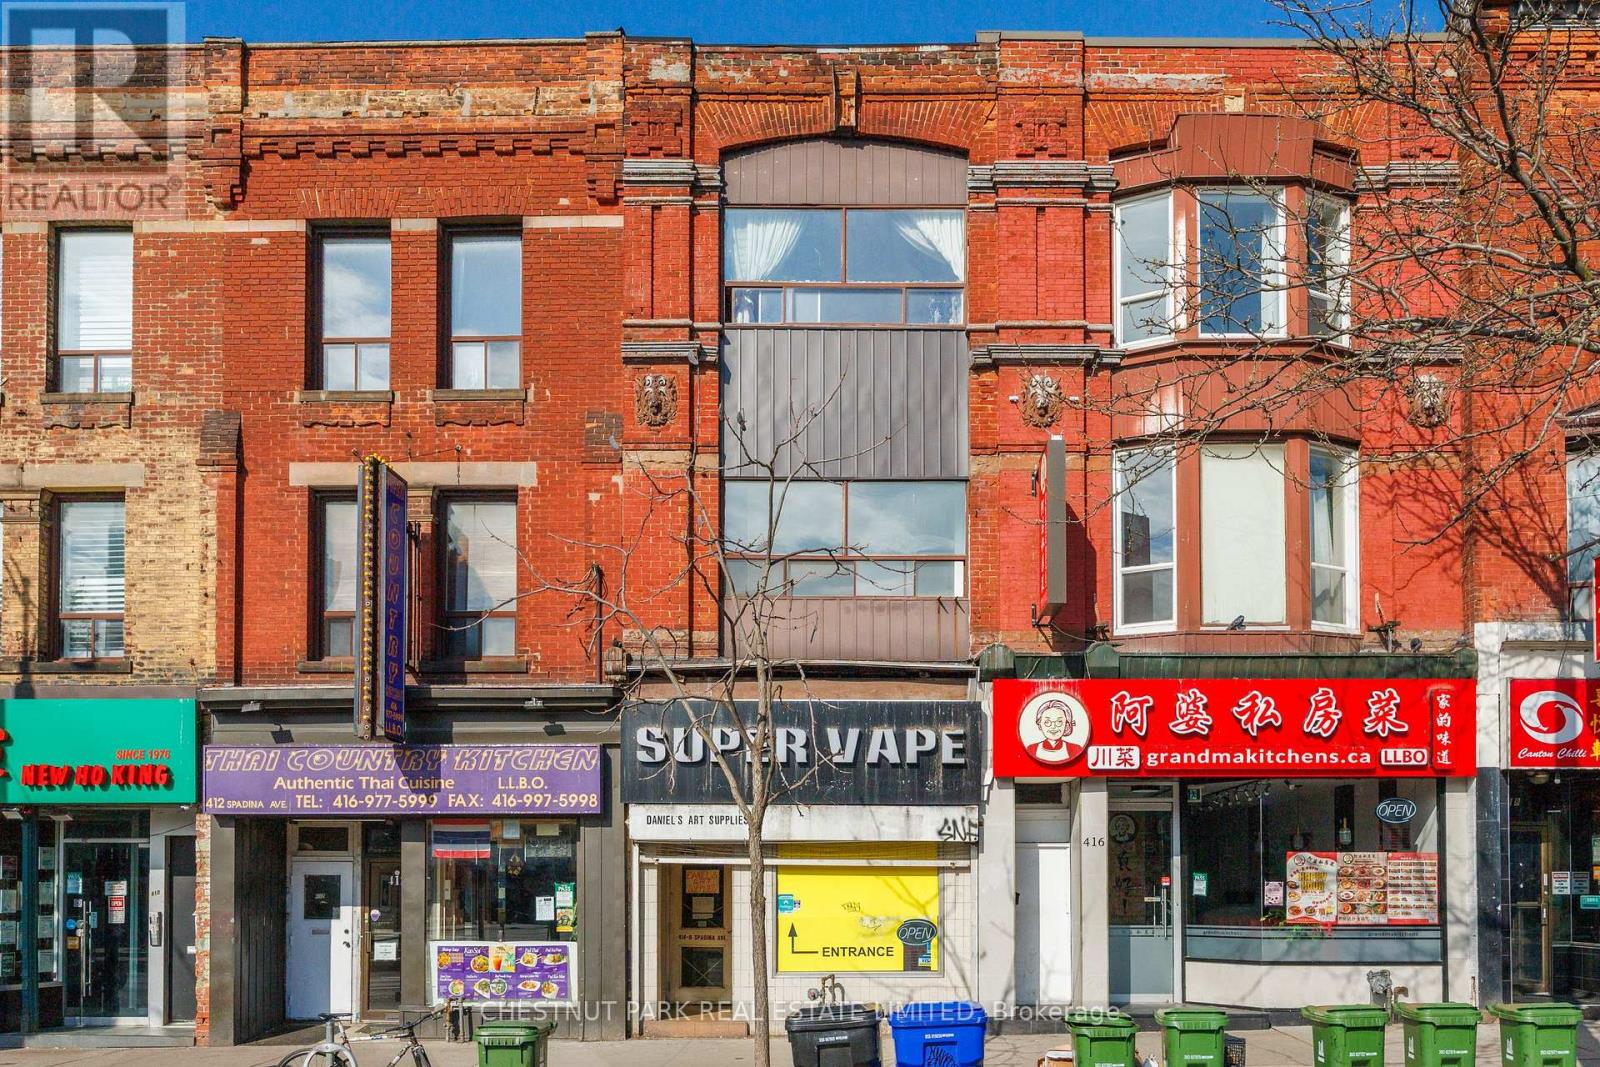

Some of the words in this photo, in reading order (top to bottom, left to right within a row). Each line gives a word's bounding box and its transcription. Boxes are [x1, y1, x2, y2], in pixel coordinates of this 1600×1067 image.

[1111, 688, 1409, 737] 阿婆私房菜
[1436, 693, 1452, 765] 家的味道
[636, 727, 807, 763] SUPER
[827, 727, 965, 764] VAPE
[116, 749, 144, 760] SINCE
[148, 749, 170, 760] 1976
[205, 749, 280, 771] THAI
[287, 749, 448, 771] COUNTRY
[454, 749, 598, 771] KITCHEN
[1091, 747, 1135, 767] 川菜
[1147, 749, 1371, 767] grandmakitchens.ca
[1384, 750, 1425, 763] LLBO
[1518, 747, 1554, 759] Canton
[1557, 747, 1587, 759] Chilli
[21, 764, 72, 786] NEW
[75, 764, 107, 786] HO
[111, 764, 170, 786] KING
[273, 776, 354, 790] Authentic
[359, 776, 394, 790] Thai
[398, 776, 455, 790] Cuisine
[498, 776, 548, 790] L.L.B.O.
[205, 798, 225, 809] 412
[226, 801, 264, 809] SPADINA
[296, 794, 323, 809] TEL:
[332, 793, 438, 809] 416-977-5999
[448, 793, 484, 808] FAX:
[492, 793, 598, 808] 416-997-5998
[1379, 805, 1413, 816] OPEN
[646, 815, 683, 825] DANIEL'S
[688, 815, 704, 825] ART
[709, 815, 749, 825] SUPPLIES
[1083, 837, 1105, 847] 416
[899, 927, 932, 940] OPEN
[822, 946, 894, 957] ENTRANCE
